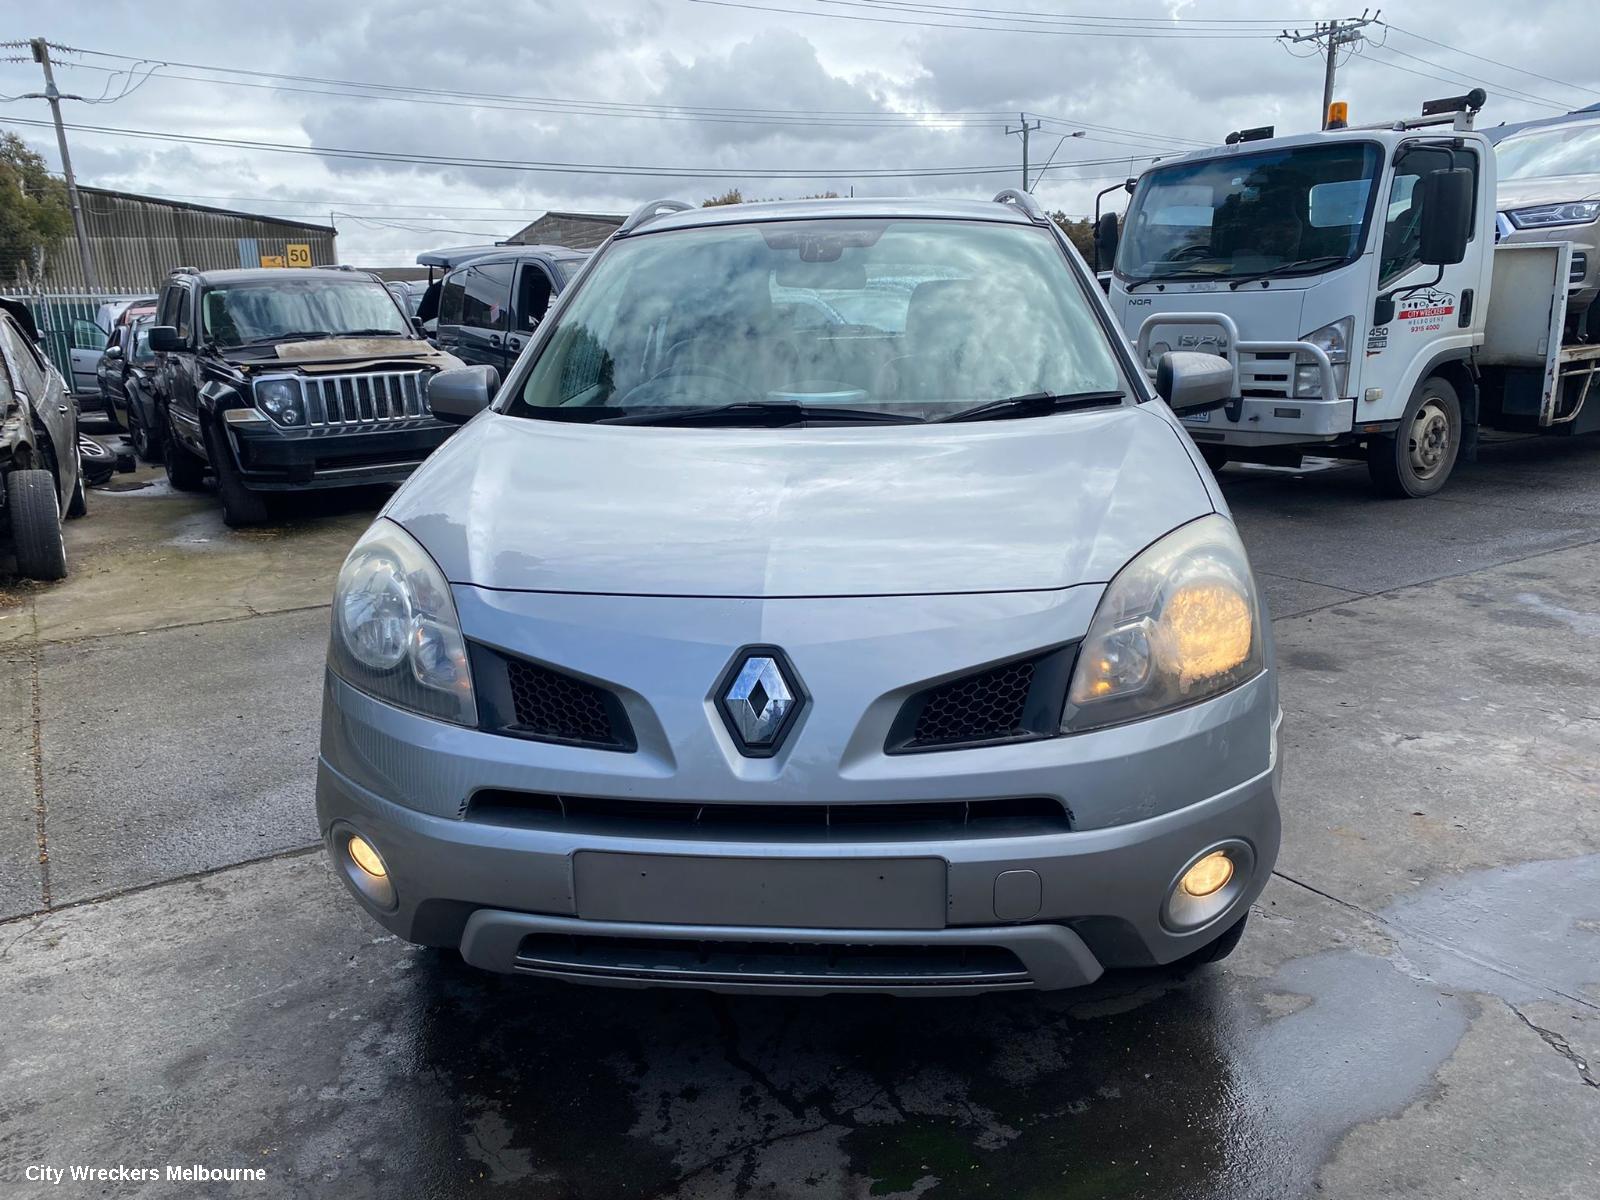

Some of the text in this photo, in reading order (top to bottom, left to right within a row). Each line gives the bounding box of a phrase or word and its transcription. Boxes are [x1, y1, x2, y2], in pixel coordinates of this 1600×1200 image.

[290, 249, 308, 262] 50
[1408, 308, 1445, 318] CITY WRECKERS
[1369, 327, 1388, 336] 450
